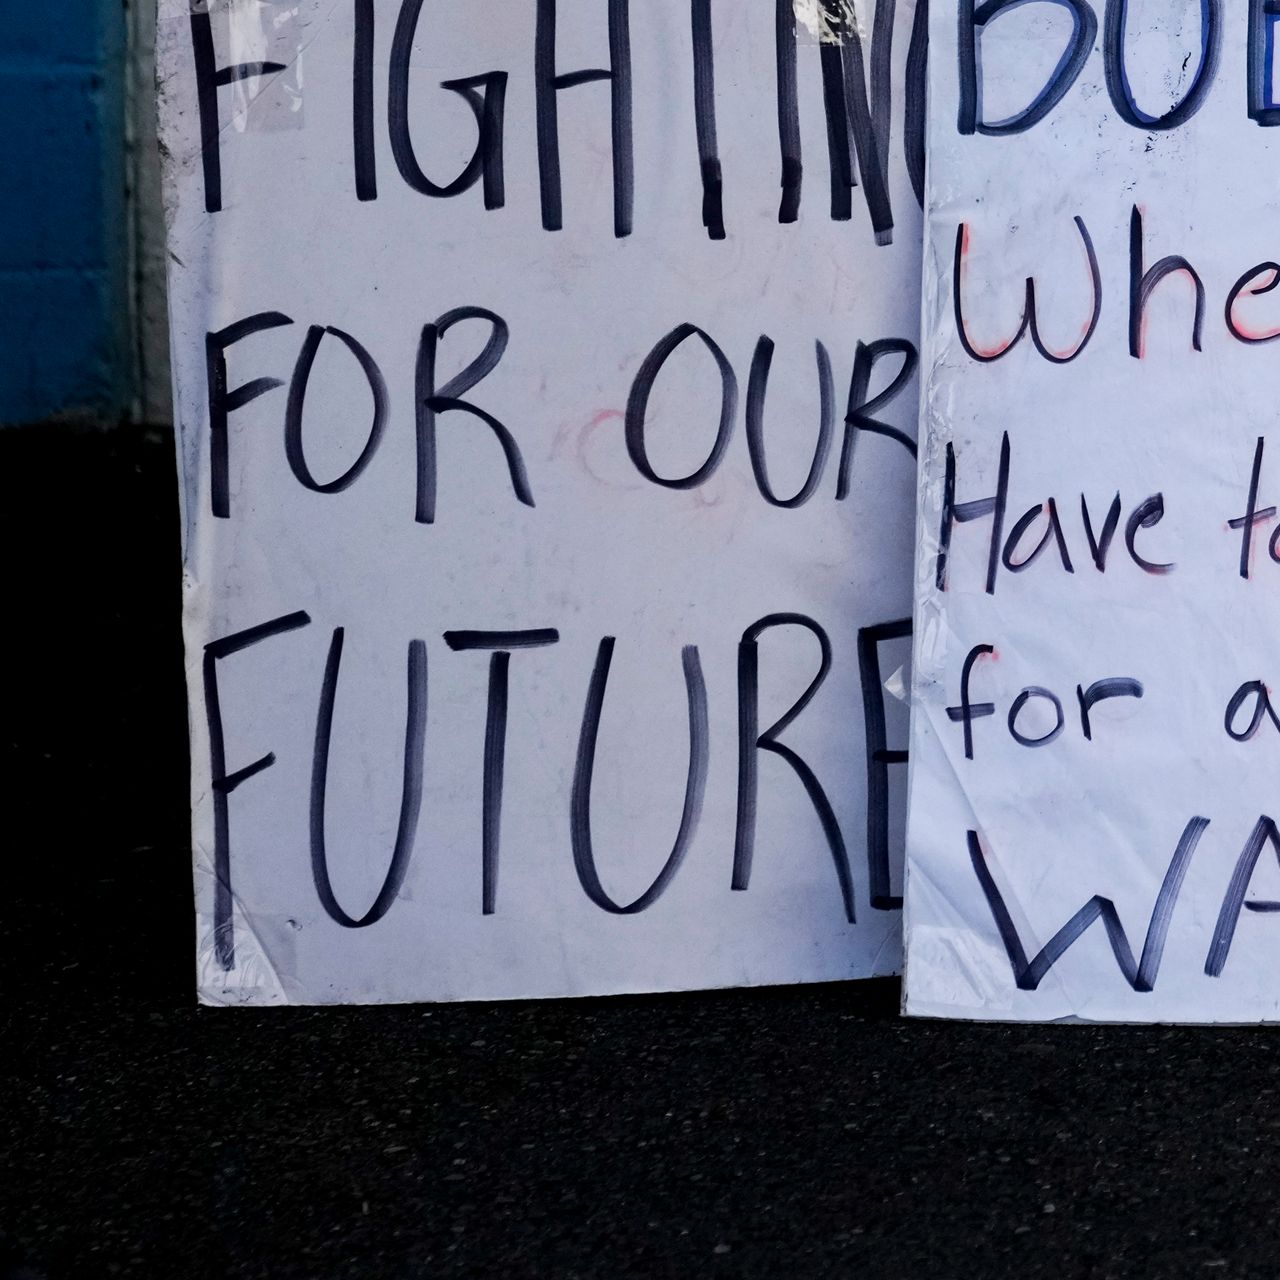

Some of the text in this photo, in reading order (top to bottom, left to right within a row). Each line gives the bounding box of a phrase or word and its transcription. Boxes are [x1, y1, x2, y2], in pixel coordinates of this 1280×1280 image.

[207, 305, 918, 524] FOR OUR
[936, 430, 1178, 595] Have
[946, 644, 1144, 760] for
